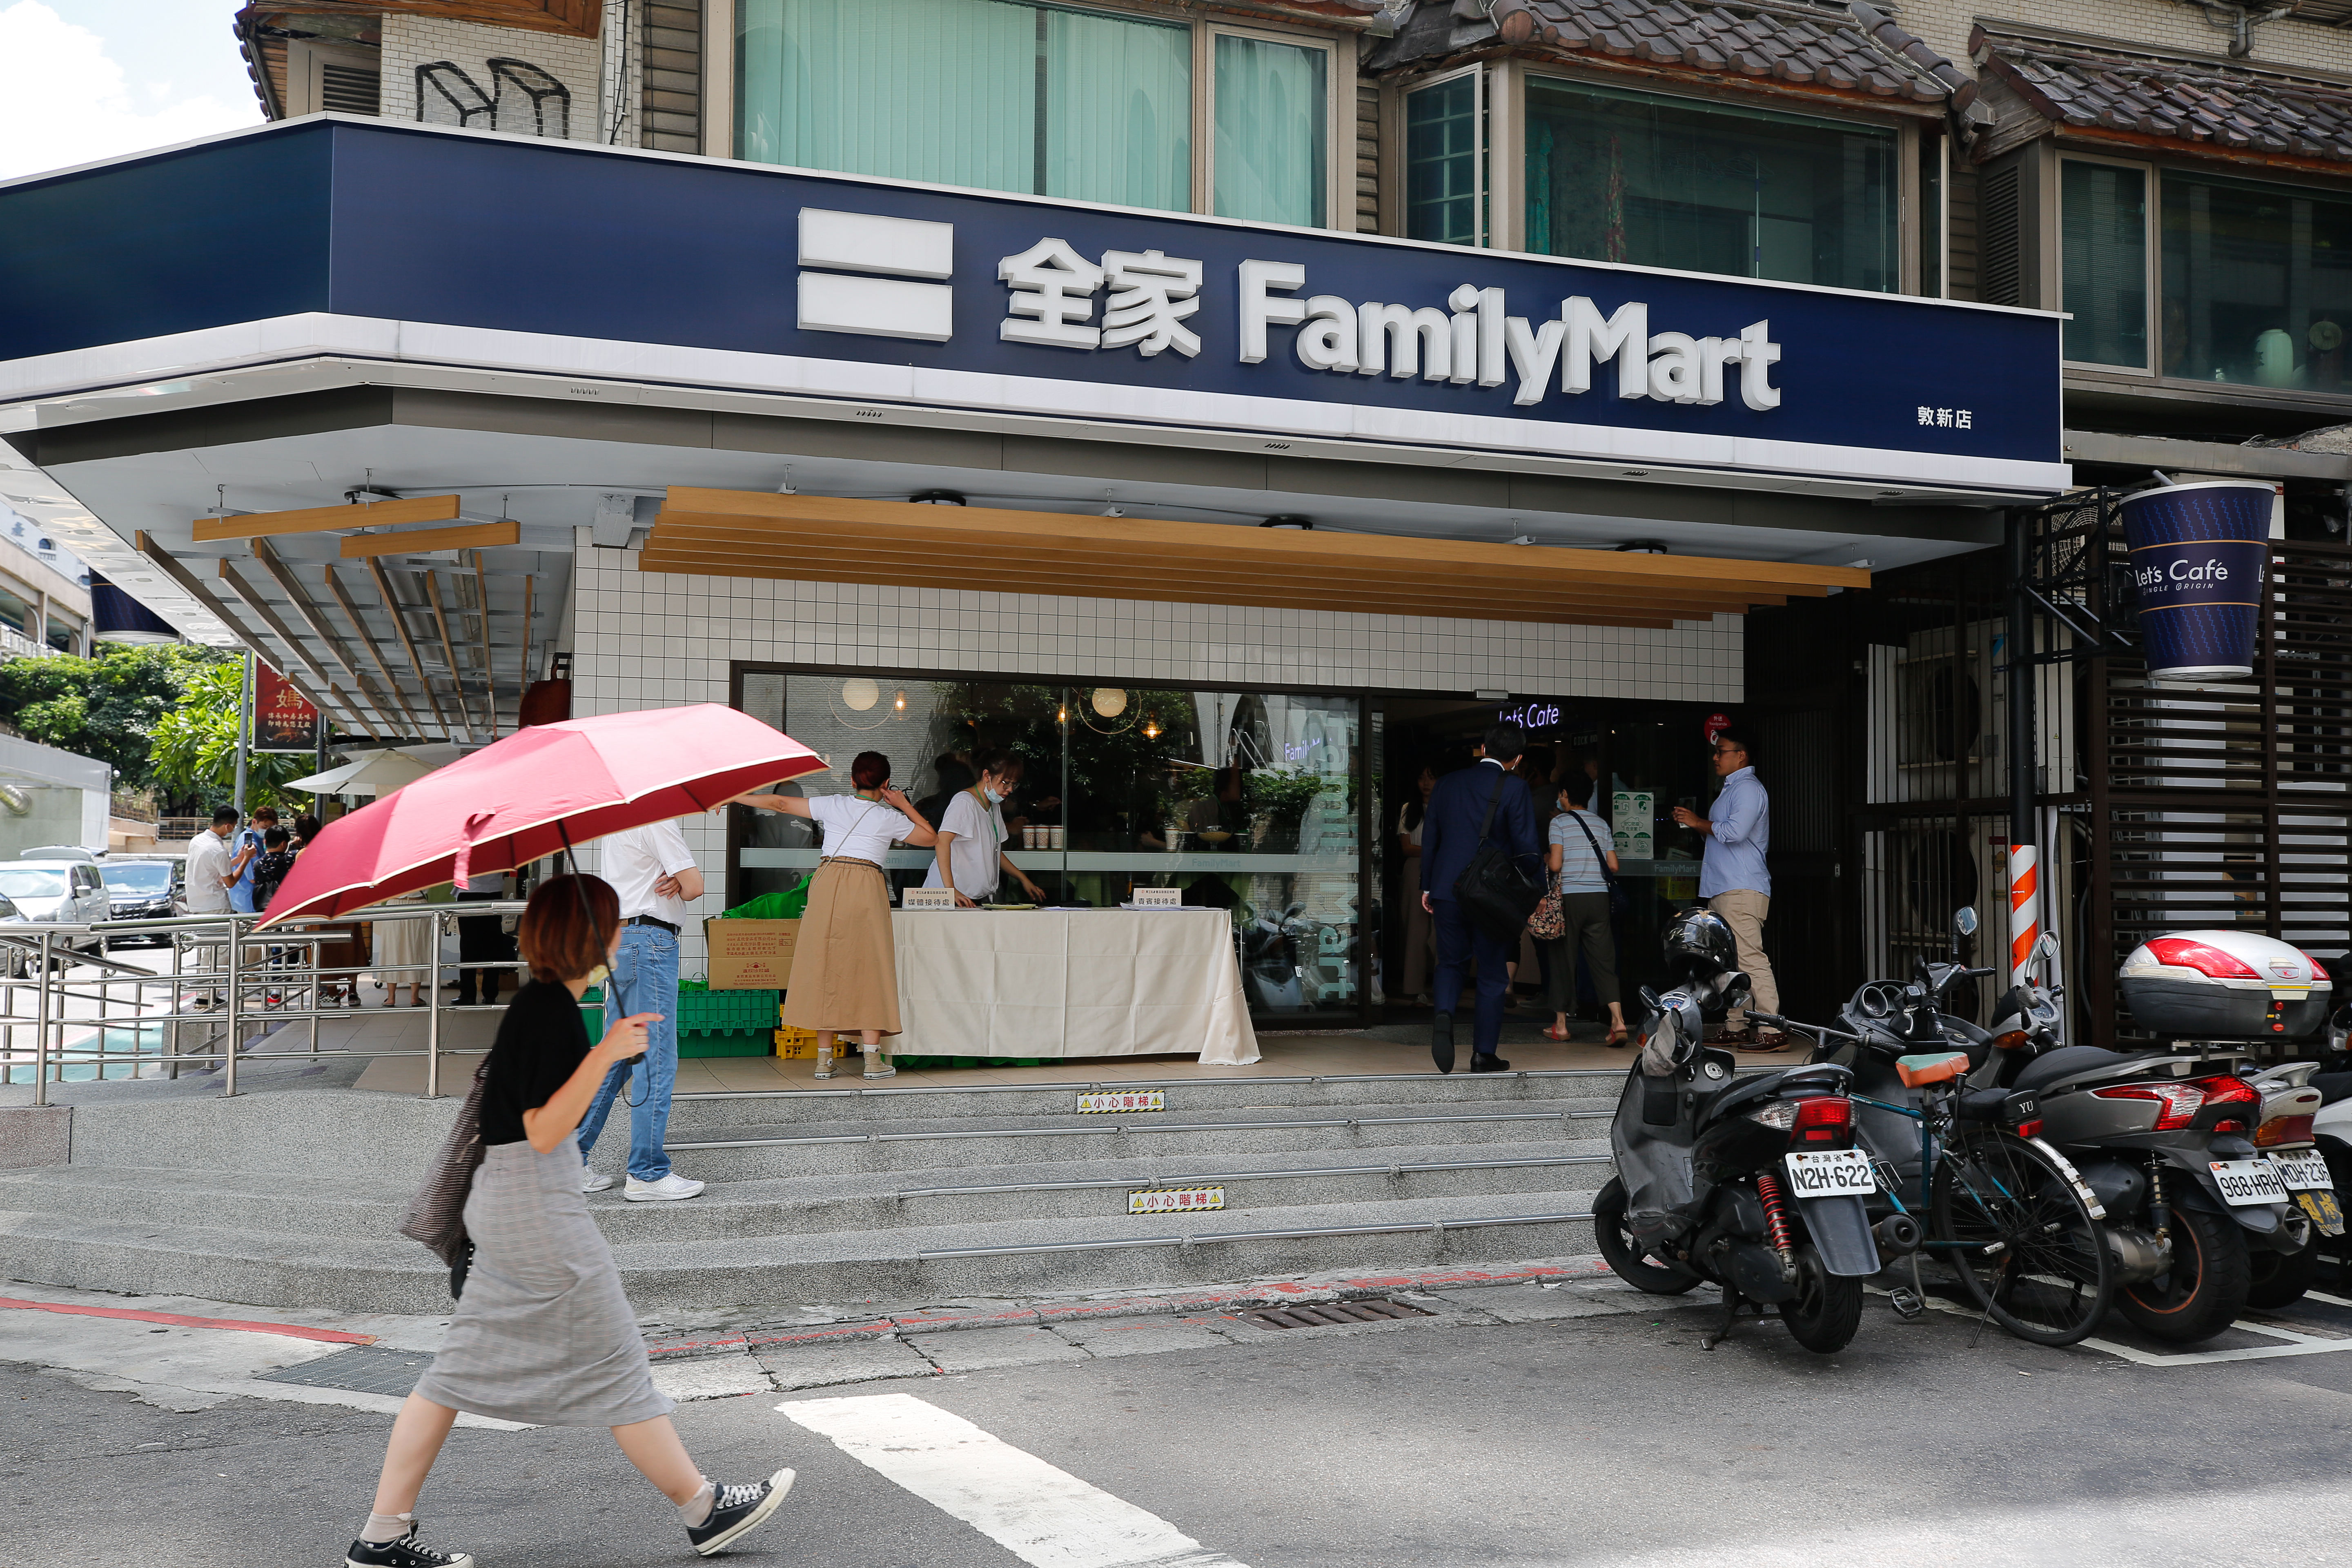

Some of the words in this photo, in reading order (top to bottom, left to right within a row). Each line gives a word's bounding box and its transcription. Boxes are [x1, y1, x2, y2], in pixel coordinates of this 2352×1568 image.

[998, 236, 1203, 358] 全家
[1239, 258, 1782, 409] FamilyMart
[1918, 406, 1972, 429] 敦新店
[2135, 566, 2163, 587] Let's
[2169, 559, 2228, 581] Café
[2143, 585, 2169, 596] SINGLE
[2176, 583, 2214, 591] ORIGIN
[1192, 858, 1241, 869] FamilyMart
[1654, 864, 1697, 874] FamilyMart
[1094, 1096, 1149, 1109] 小心階梯
[2019, 1100, 2033, 1113] YU
[1811, 1154, 1842, 1163] 台灣省
[1147, 1193, 1207, 1208] 小心階梯
